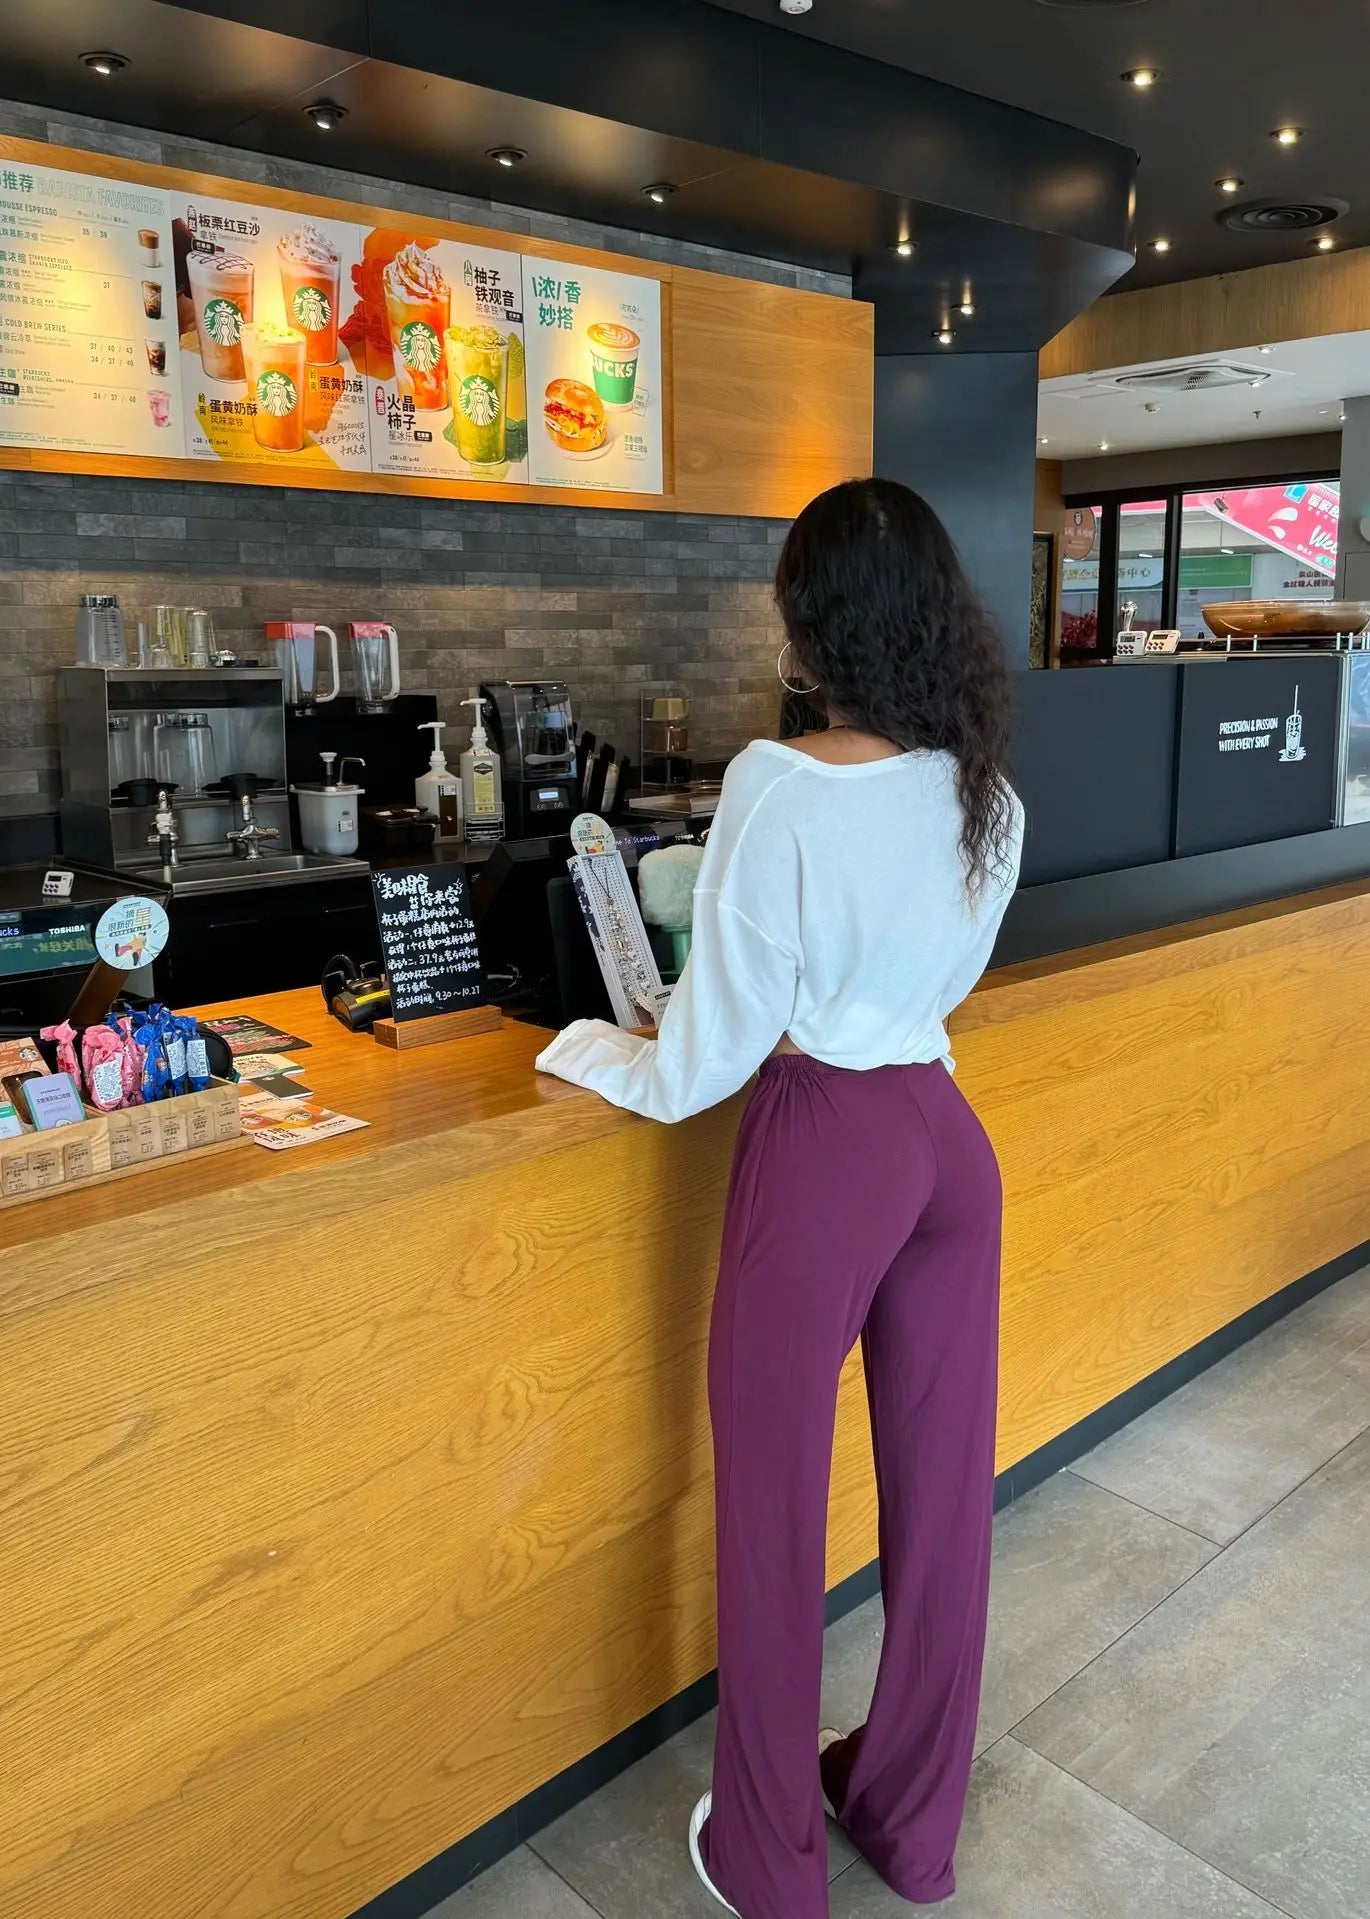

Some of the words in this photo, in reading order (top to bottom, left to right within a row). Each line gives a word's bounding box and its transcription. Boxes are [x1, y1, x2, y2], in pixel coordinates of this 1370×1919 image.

[25, 204, 58, 216] ESPRESSO
[98, 188, 165, 216] FAVORITES
[198, 213, 260, 236] 板栗红豆沙
[474, 266, 500, 286] 柚子
[475, 286, 514, 307] 铁观音
[5, 318, 22, 328] COLD
[24, 320, 42, 330] BREW
[44, 323, 66, 332] SERIES
[539, 303, 574, 330] 妙搭
[320, 376, 363, 393] 蛋黄奶酥
[210, 400, 258, 416] 蛋黄奶酥
[387, 394, 415, 413] 火晶
[211, 416, 244, 426] 风味拿铁
[388, 412, 416, 430] 柿子
[389, 430, 414, 442] 星冰乐
[1219, 720, 1251, 735] PRECISION
[1256, 717, 1278, 731] PASSION
[1219, 739, 1235, 752] WITH
[1235, 737, 1255, 750] EVERY
[1255, 734, 1271, 748] SHOT
[633, 835, 660, 844] Starbucks
[49, 925, 85, 935] TOSHIBA
